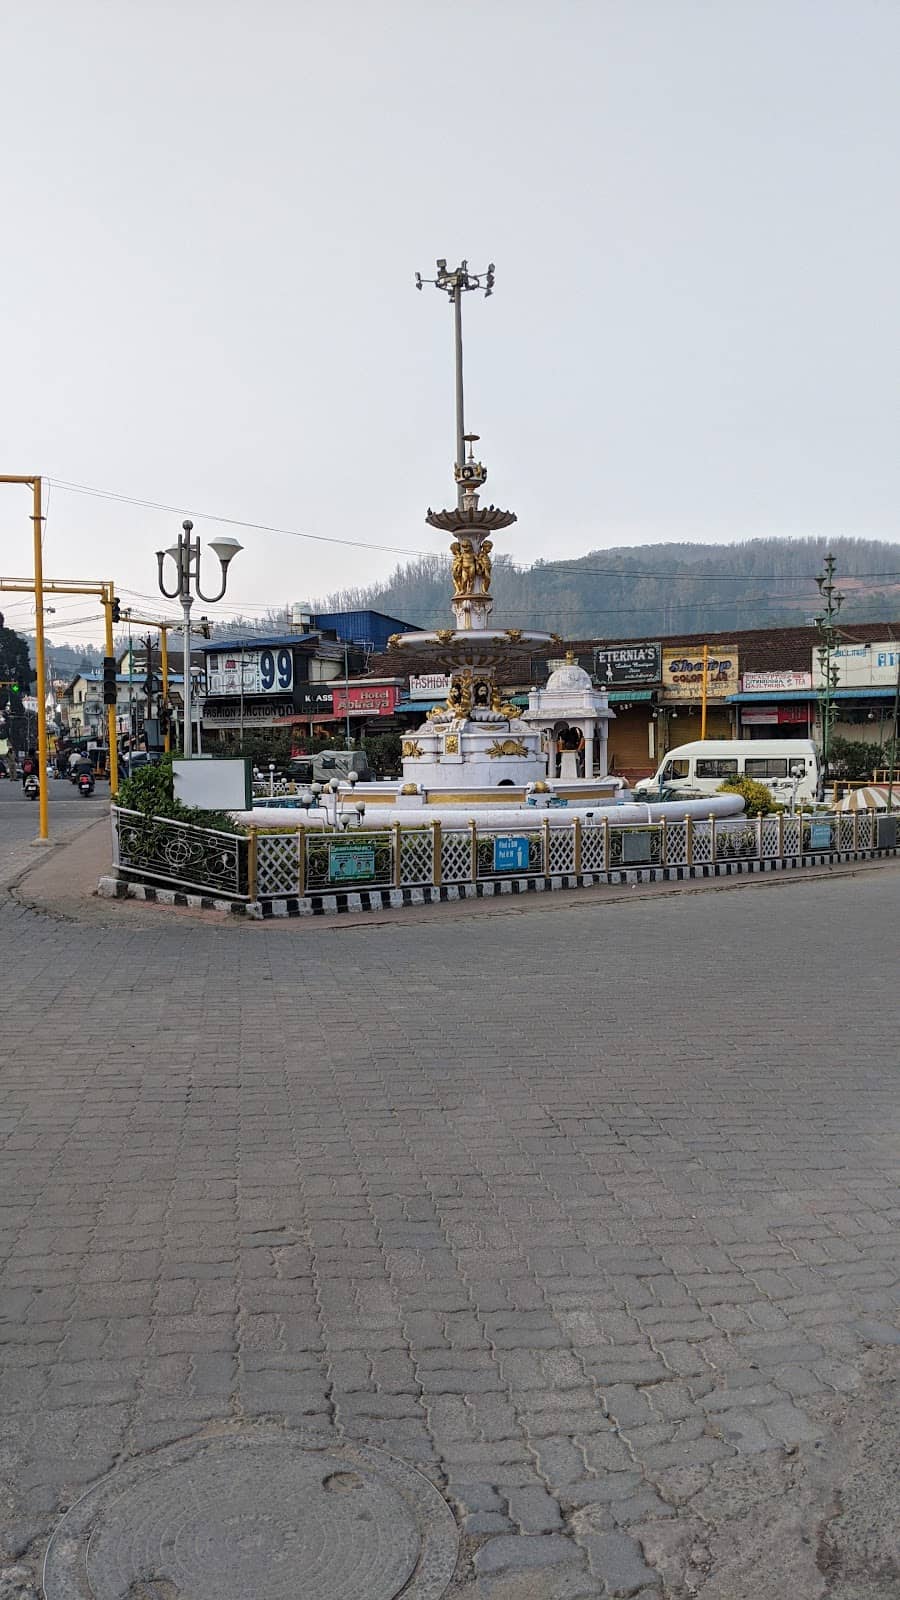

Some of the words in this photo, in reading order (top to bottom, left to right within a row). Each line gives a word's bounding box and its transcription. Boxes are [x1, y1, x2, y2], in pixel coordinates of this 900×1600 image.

[599, 648, 656, 663] ETERNIA'S
[669, 659, 732, 673] Sharp
[411, 676, 449, 689] FASHION
[360, 690, 389, 699] Hotel
[203, 705, 236, 718] FASHION
[238, 703, 277, 718] JUNCTION
